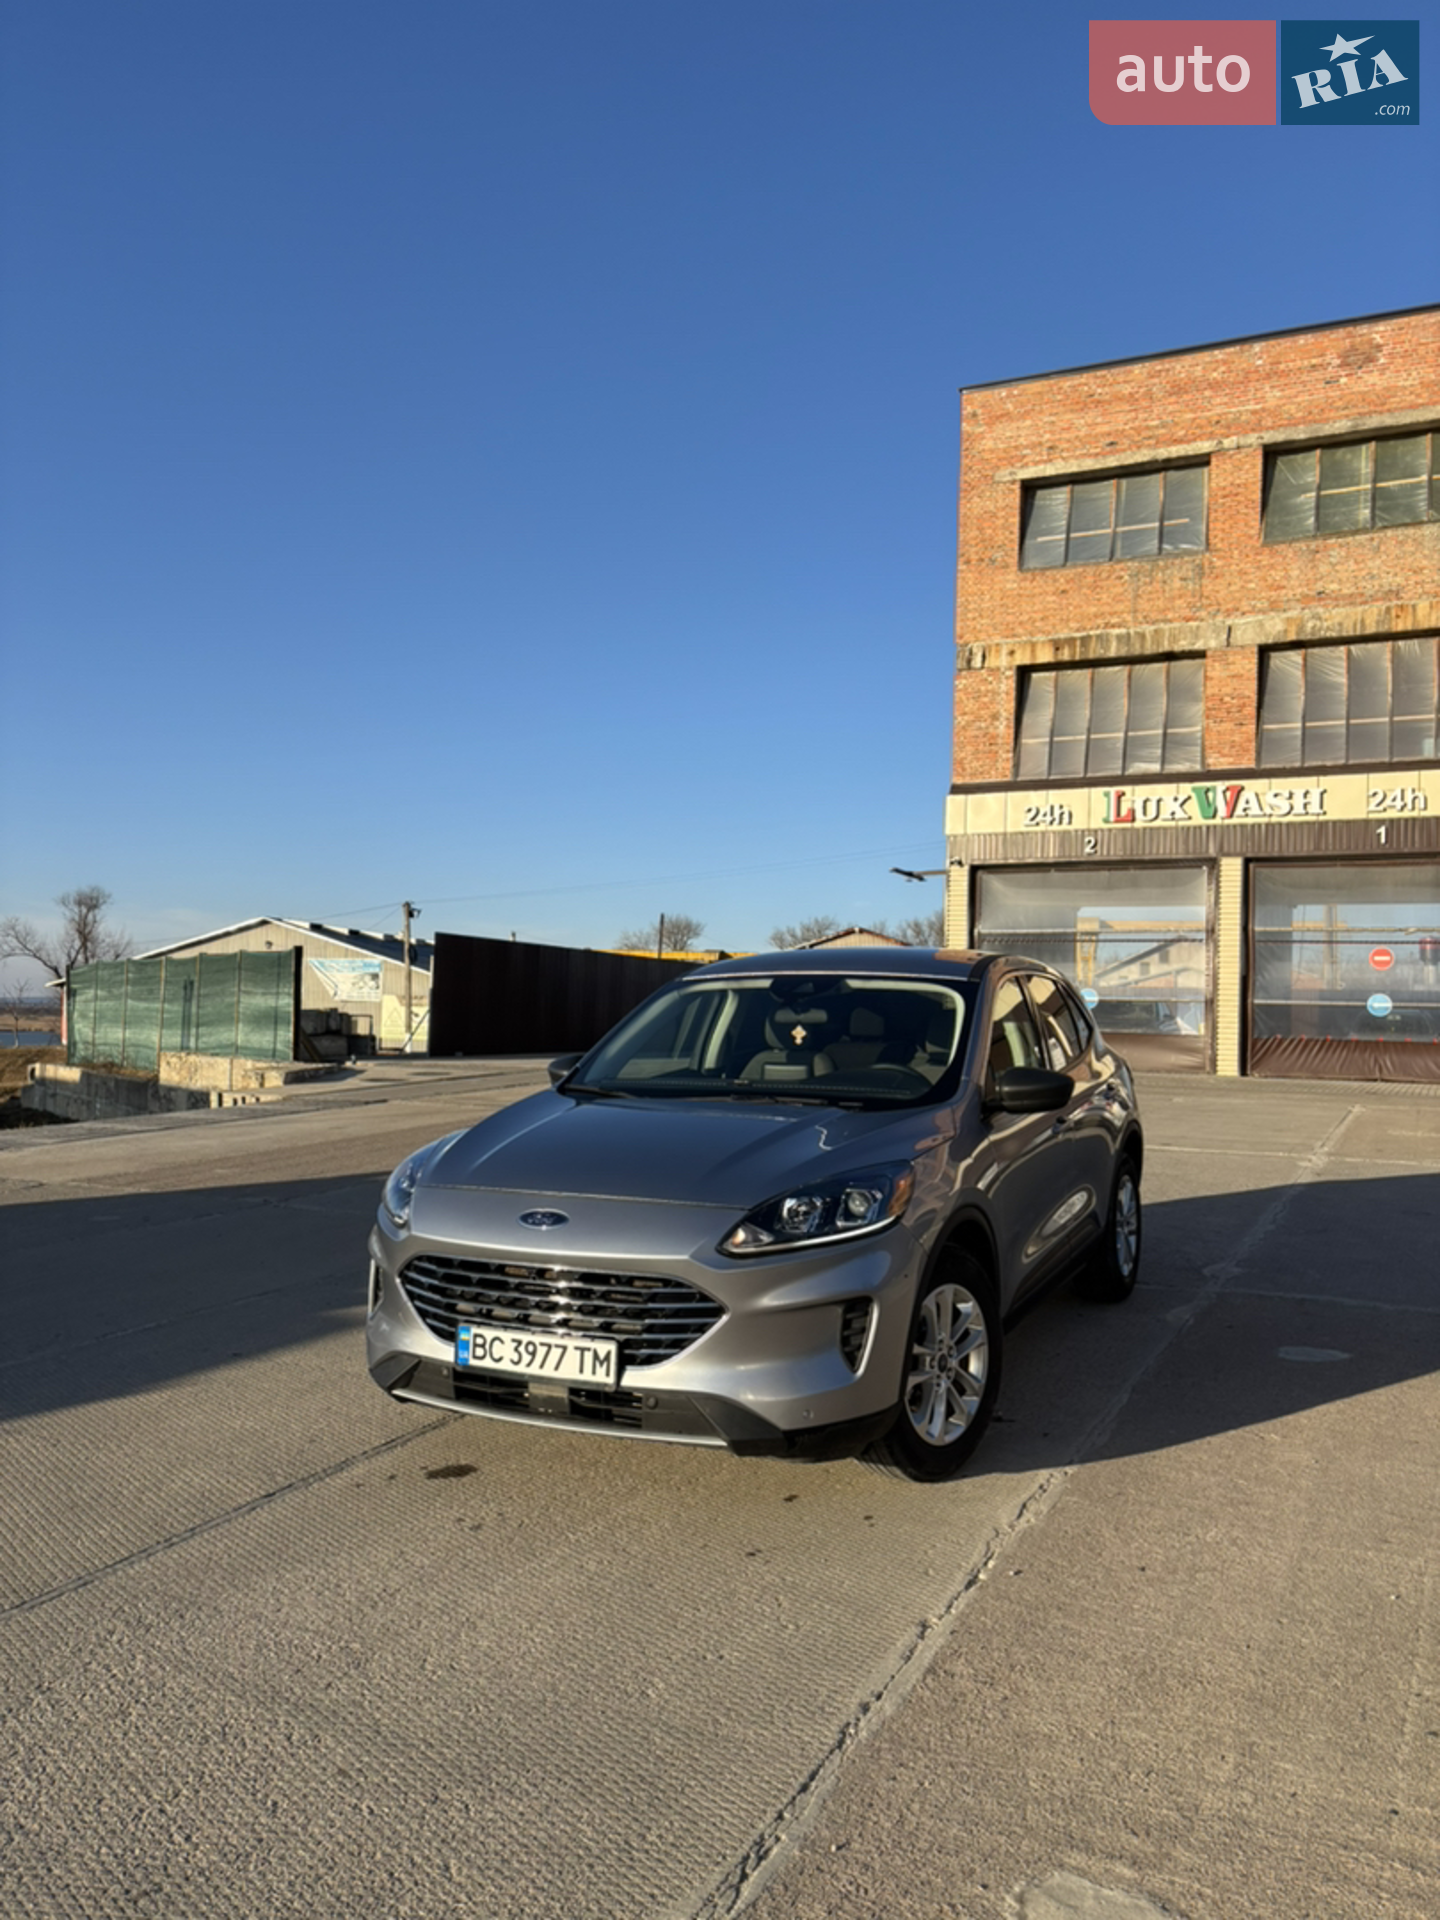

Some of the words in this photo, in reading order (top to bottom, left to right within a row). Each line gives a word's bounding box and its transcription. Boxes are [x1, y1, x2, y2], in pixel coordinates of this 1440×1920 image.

[1367, 787, 1428, 813] 24h
[1024, 804, 1073, 827] 24h
[1084, 835, 1098, 855] 2
[1376, 824, 1388, 846] 1
[472, 1333, 505, 1363] BC
[509, 1338, 568, 1371] 3977
[573, 1345, 612, 1378] TM
